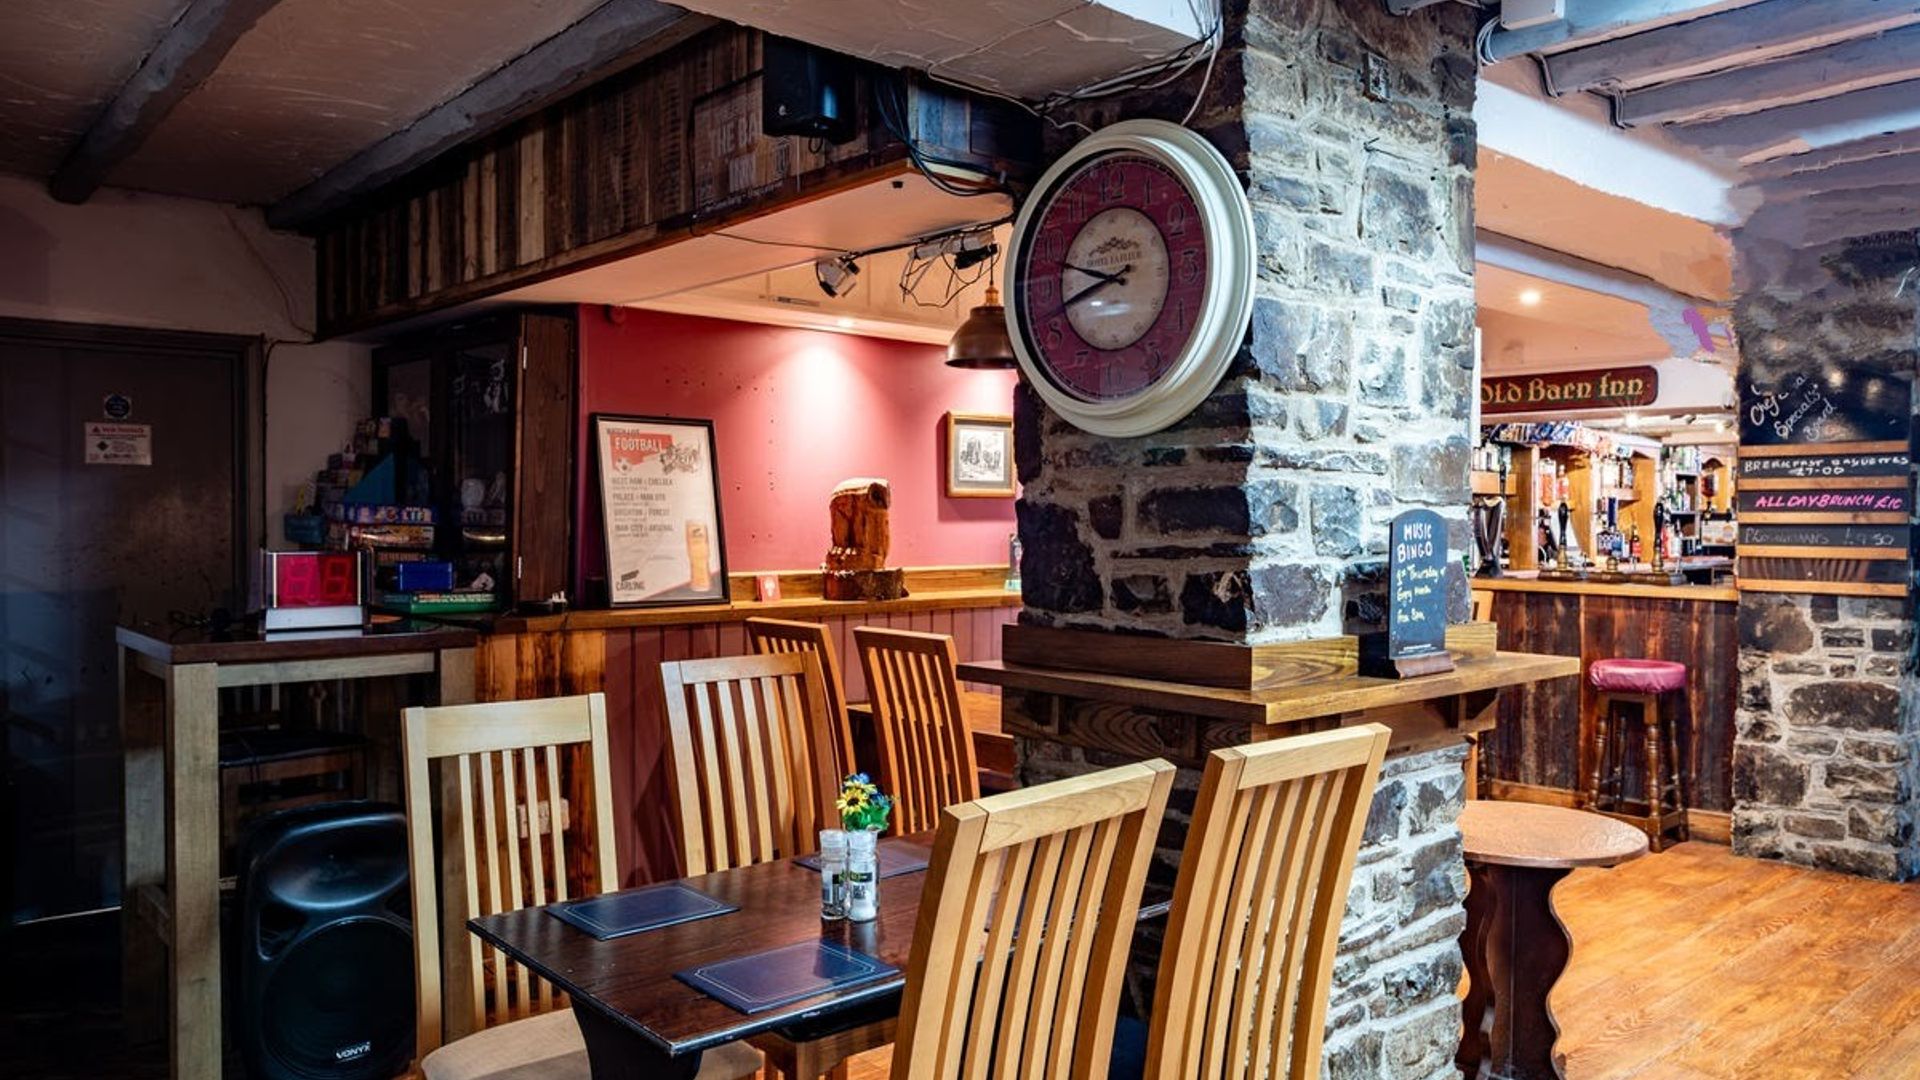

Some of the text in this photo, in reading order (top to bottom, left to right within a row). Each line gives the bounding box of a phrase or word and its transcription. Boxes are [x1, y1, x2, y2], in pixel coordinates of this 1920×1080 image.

[1481, 371, 1645, 404] Old Barn Inn
[614, 437, 663, 453] FOOTBALL
[1744, 459, 1824, 473] BREAKFAST
[1755, 496, 1785, 508] ALL
[1816, 494, 1875, 508] BRUNCH
[1403, 522, 1432, 541] MUSIC
[1397, 541, 1433, 563] BINGO
[335, 1041, 372, 1060] VONYX
